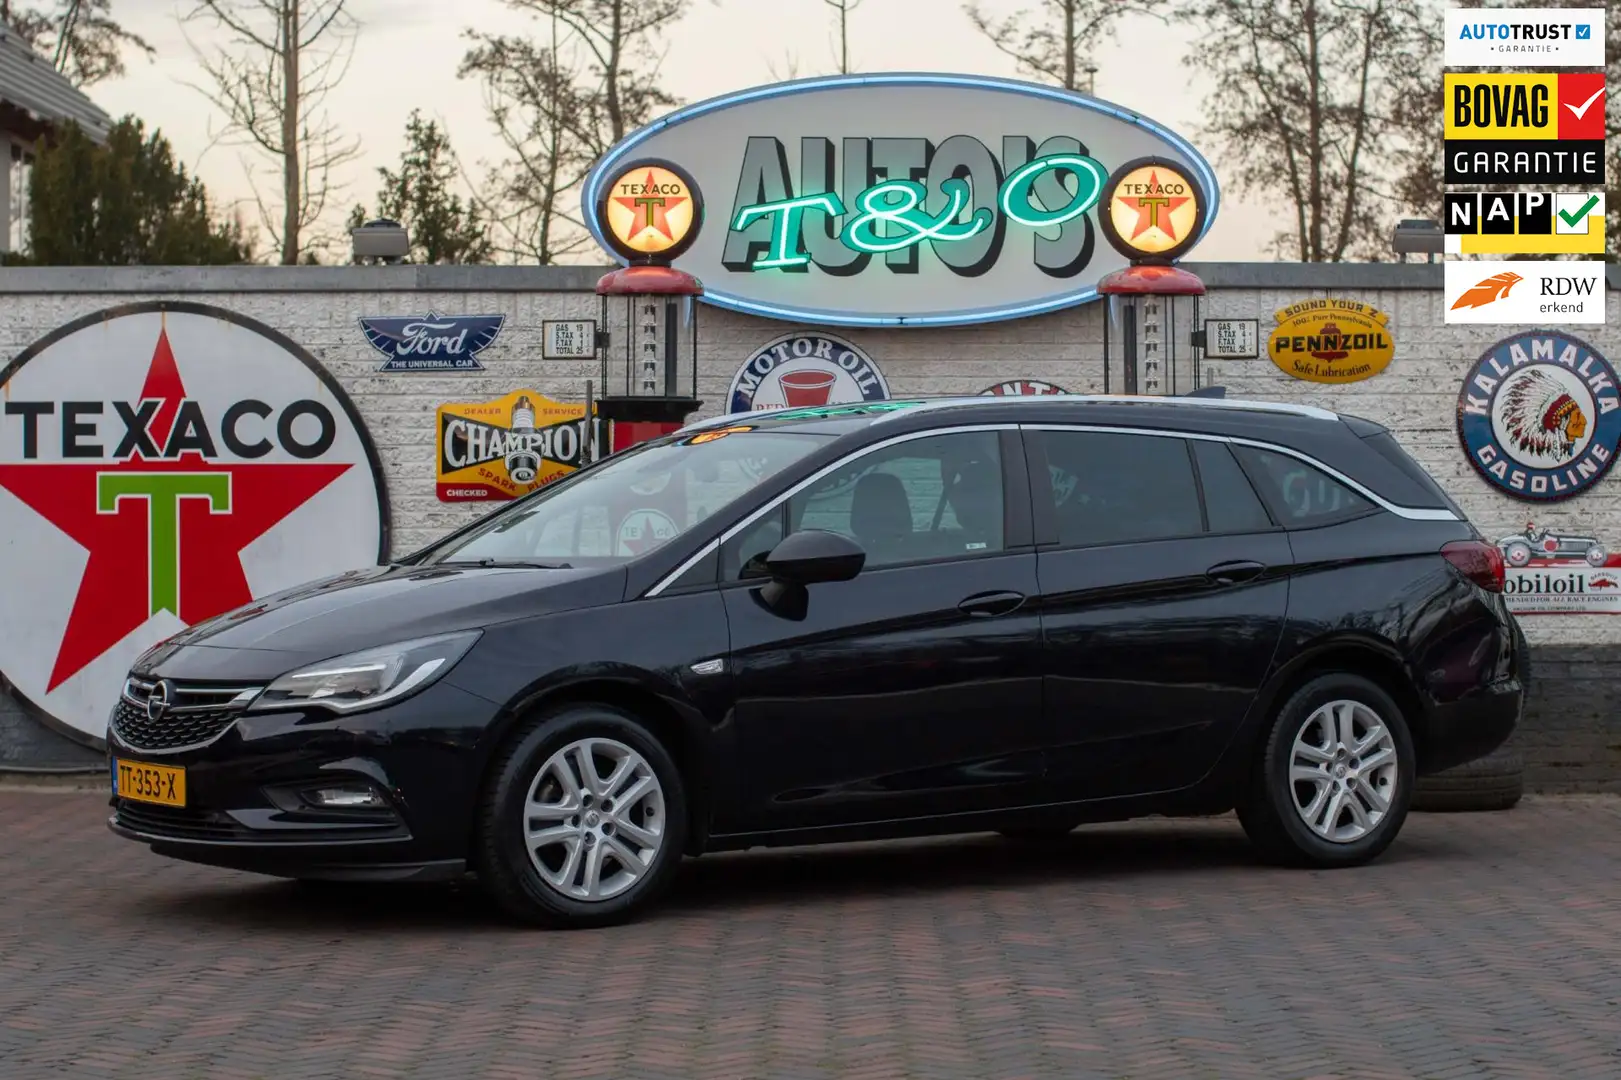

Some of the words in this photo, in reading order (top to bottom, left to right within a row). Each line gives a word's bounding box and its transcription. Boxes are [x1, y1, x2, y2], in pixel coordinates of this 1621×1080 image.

[620, 184, 681, 195] TEXACO
[1124, 184, 1184, 195] TEXACO
[722, 135, 1095, 277] AUTO'S
[1284, 300, 1327, 317] SOUND
[1331, 300, 1364, 312] YOUR
[1217, 322, 1231, 330] GAS
[396, 322, 469, 356] Ford
[1217, 345, 1237, 353] TOTAL
[1275, 333, 1388, 353] PENNZOIL
[391, 361, 407, 369] THE
[408, 360, 454, 368] UNIVERSAL
[455, 360, 473, 368] CAR
[736, 338, 834, 398] MOTOR
[838, 351, 878, 395] OIL
[1292, 359, 1314, 374] Safe
[1314, 362, 1372, 377] Lubrication
[1465, 339, 1620, 416] KALAMALKA
[5, 398, 337, 459] TEXACO
[444, 418, 601, 468] CHAMPION
[1477, 443, 1610, 493] GASOLINE
[478, 468, 517, 491] SPARK
[446, 488, 488, 497] CHECKED
[97, 471, 232, 617] T
[1503, 573, 1584, 594] obiloil
[120, 765, 176, 799] TT-353-X
